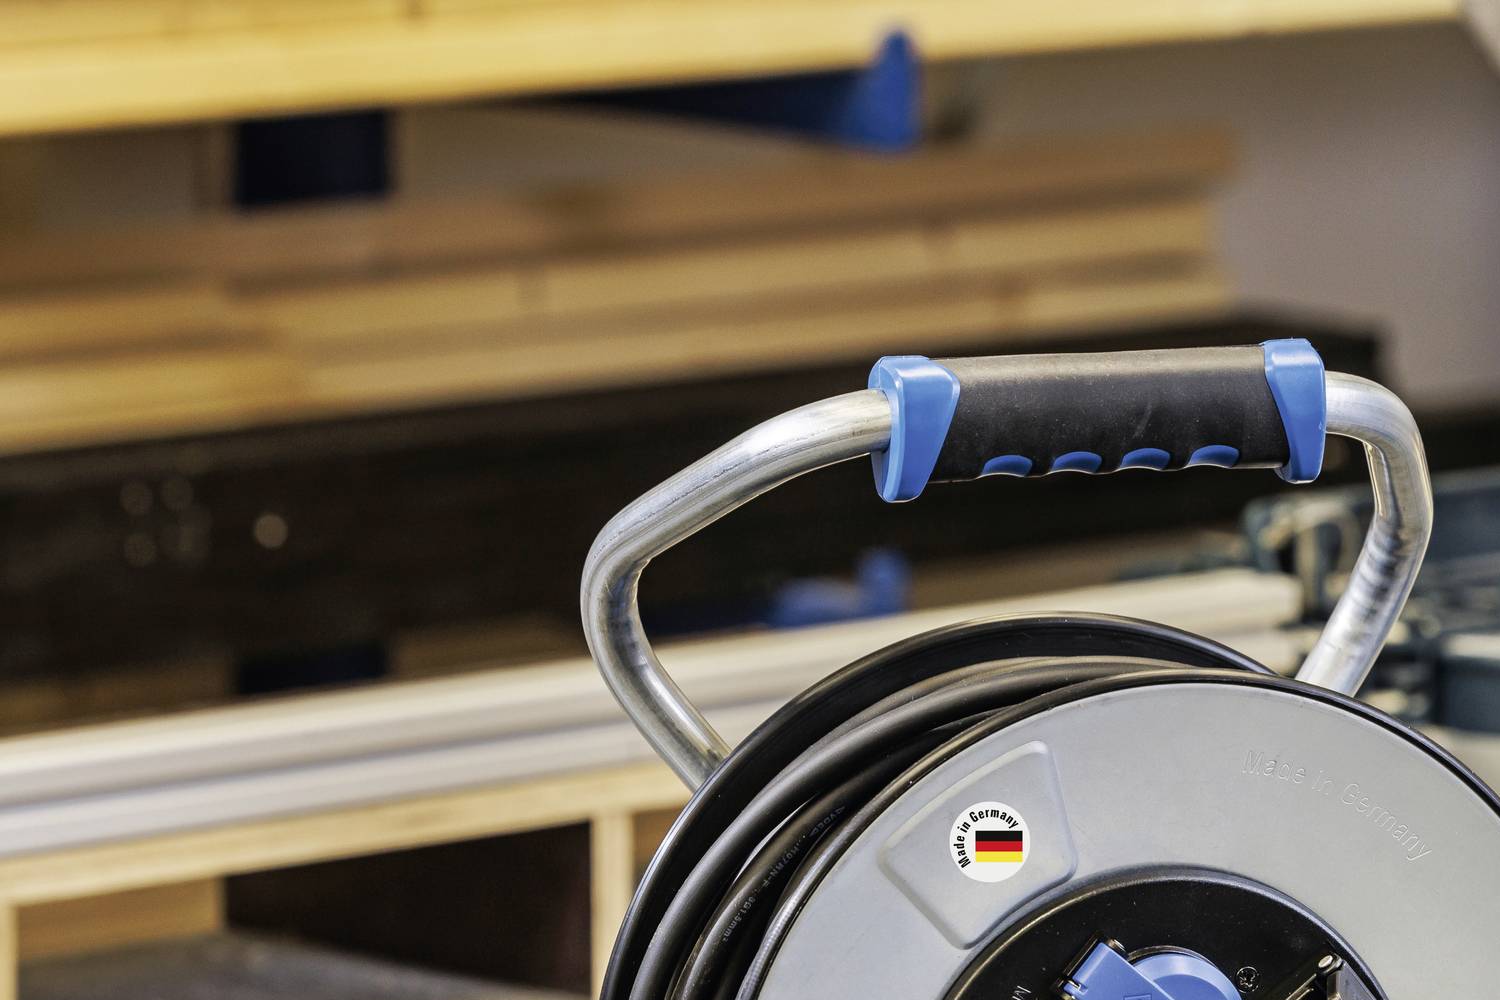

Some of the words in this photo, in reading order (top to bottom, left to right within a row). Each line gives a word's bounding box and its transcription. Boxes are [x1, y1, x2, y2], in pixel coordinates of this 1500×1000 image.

[1241, 750, 1306, 784] Made
[1340, 783, 1432, 861] Germany
[957, 821, 971, 833] in
[968, 809, 1019, 829] Germany
[953, 835, 971, 868] Made
